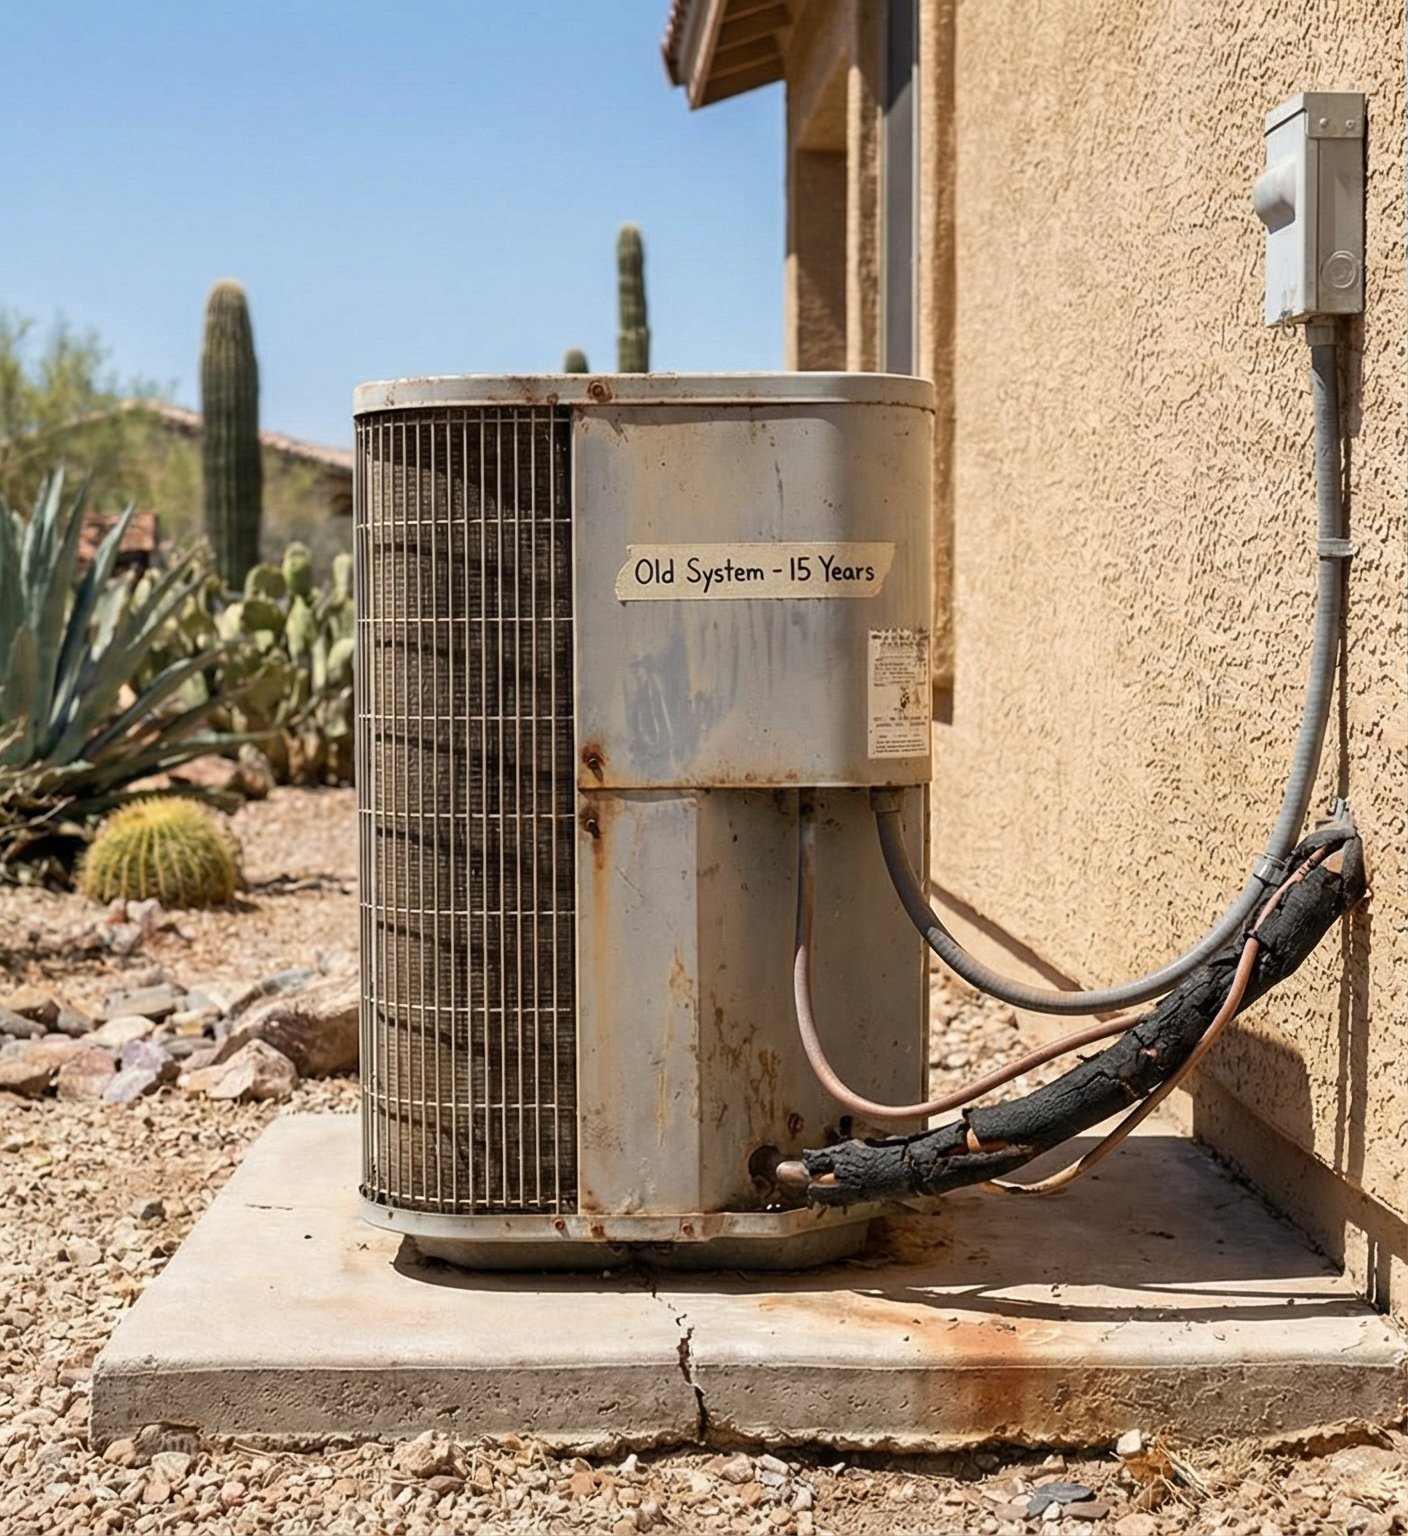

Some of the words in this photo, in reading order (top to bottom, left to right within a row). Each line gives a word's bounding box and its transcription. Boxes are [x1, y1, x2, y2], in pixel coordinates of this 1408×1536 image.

[635, 558, 675, 584] Old
[686, 557, 764, 593] System
[790, 557, 811, 581] 15
[818, 555, 875, 582] Years
